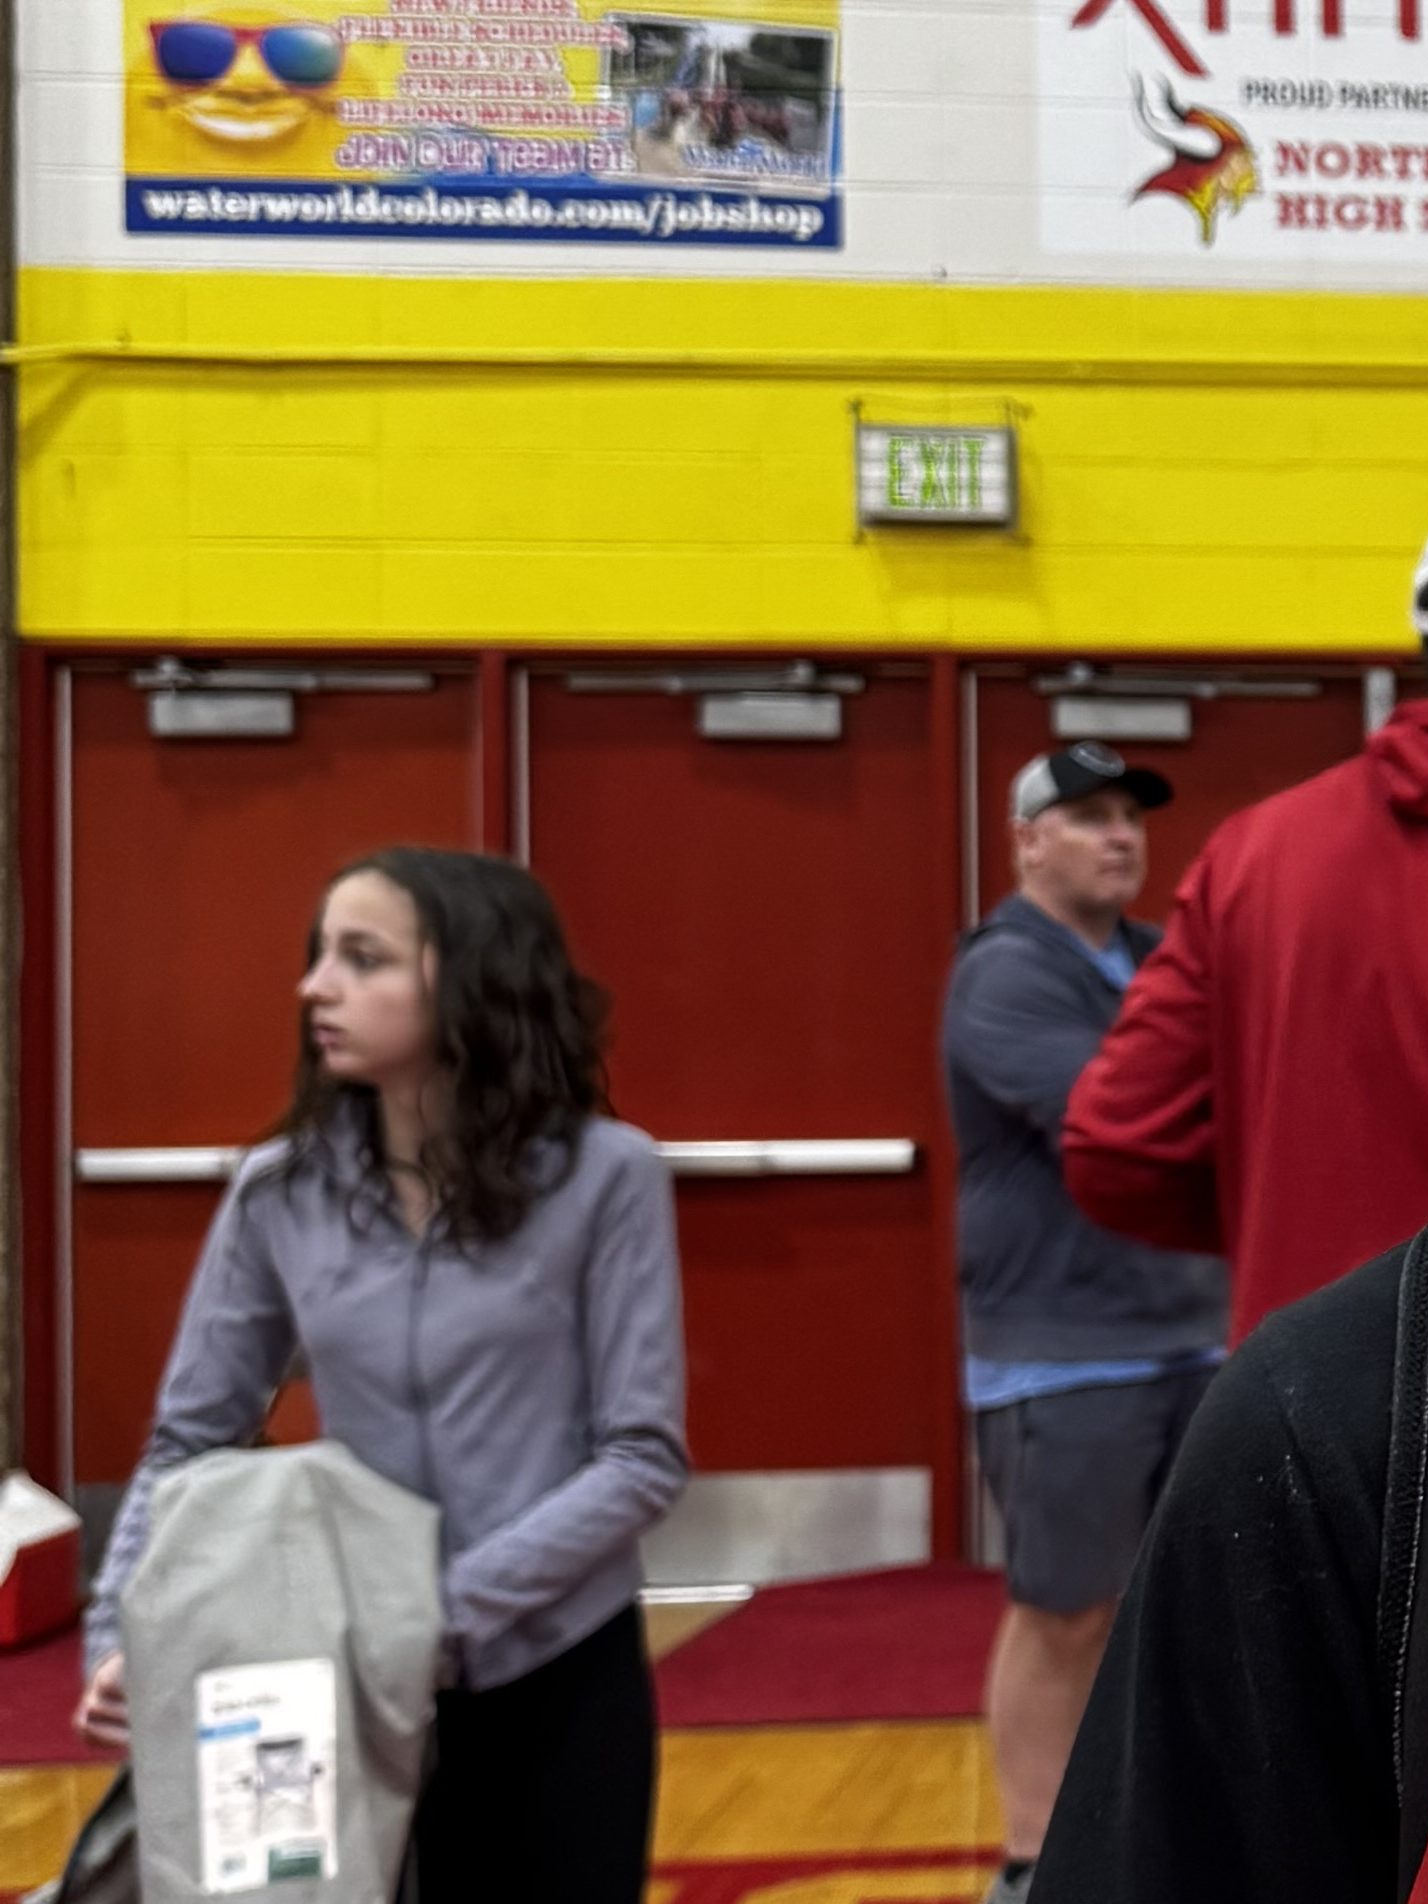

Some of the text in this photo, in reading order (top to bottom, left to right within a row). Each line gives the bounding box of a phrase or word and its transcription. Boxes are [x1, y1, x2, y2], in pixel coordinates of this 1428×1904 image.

[1245, 79, 1328, 110] PROUD
[1278, 193, 1410, 231] HIGH
[887, 435, 985, 509] EXIT
